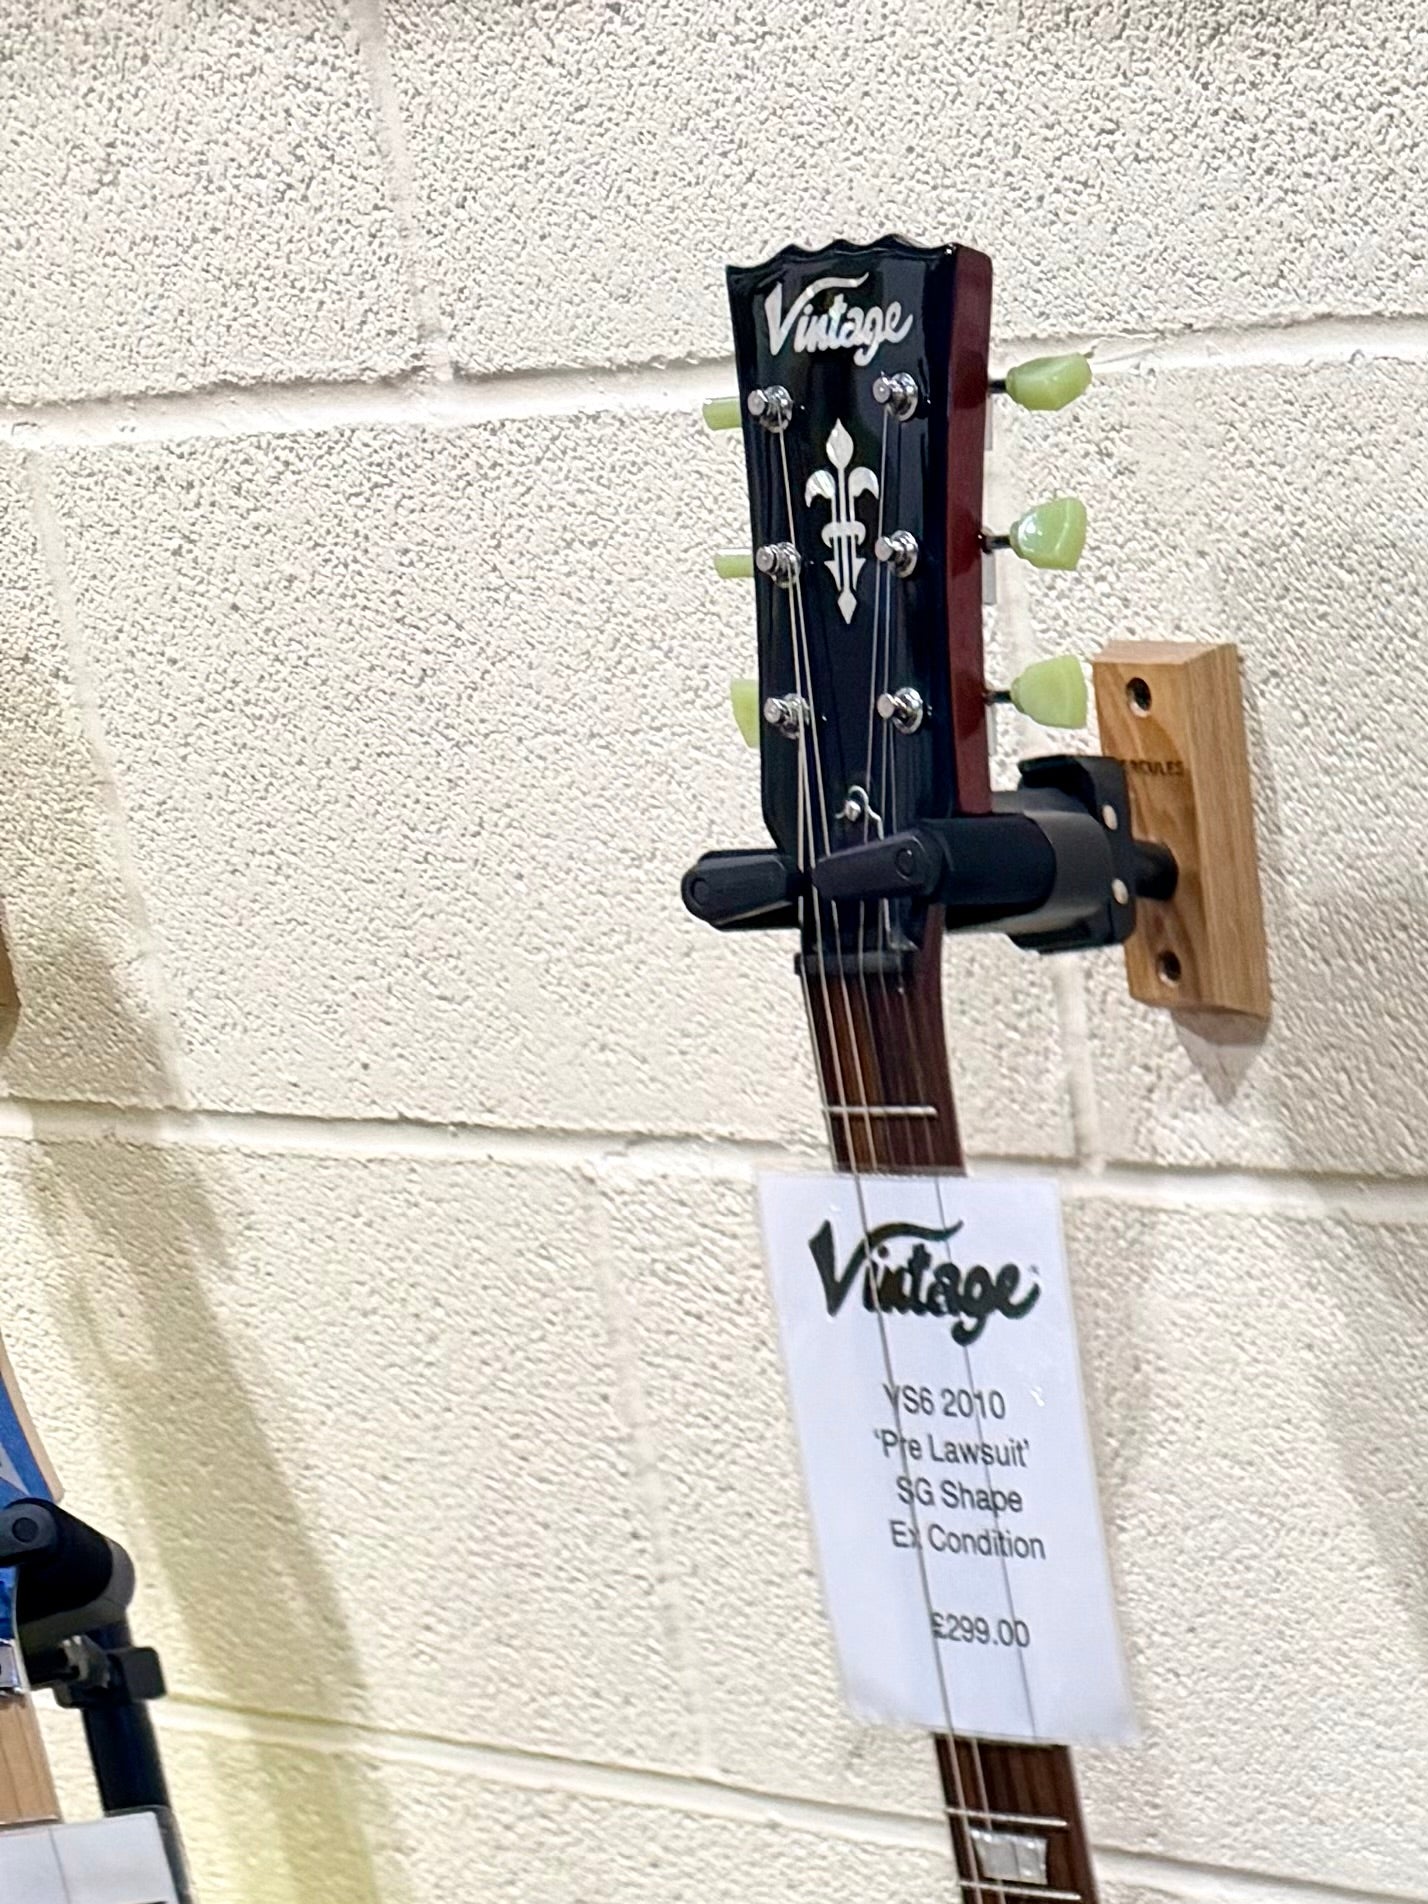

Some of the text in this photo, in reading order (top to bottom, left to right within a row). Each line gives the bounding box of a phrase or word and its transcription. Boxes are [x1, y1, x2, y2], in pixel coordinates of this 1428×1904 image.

[764, 272, 912, 366] Vintage
[809, 1219, 1040, 1346] Vintage
[882, 1382, 1006, 1419] VS6 2010
[928, 1433, 1029, 1468] Lawsuit'
[896, 1475, 1023, 1518] SG Shape
[888, 1518, 1047, 1560] Ex Condition
[931, 1612, 1031, 1648] £299.00
